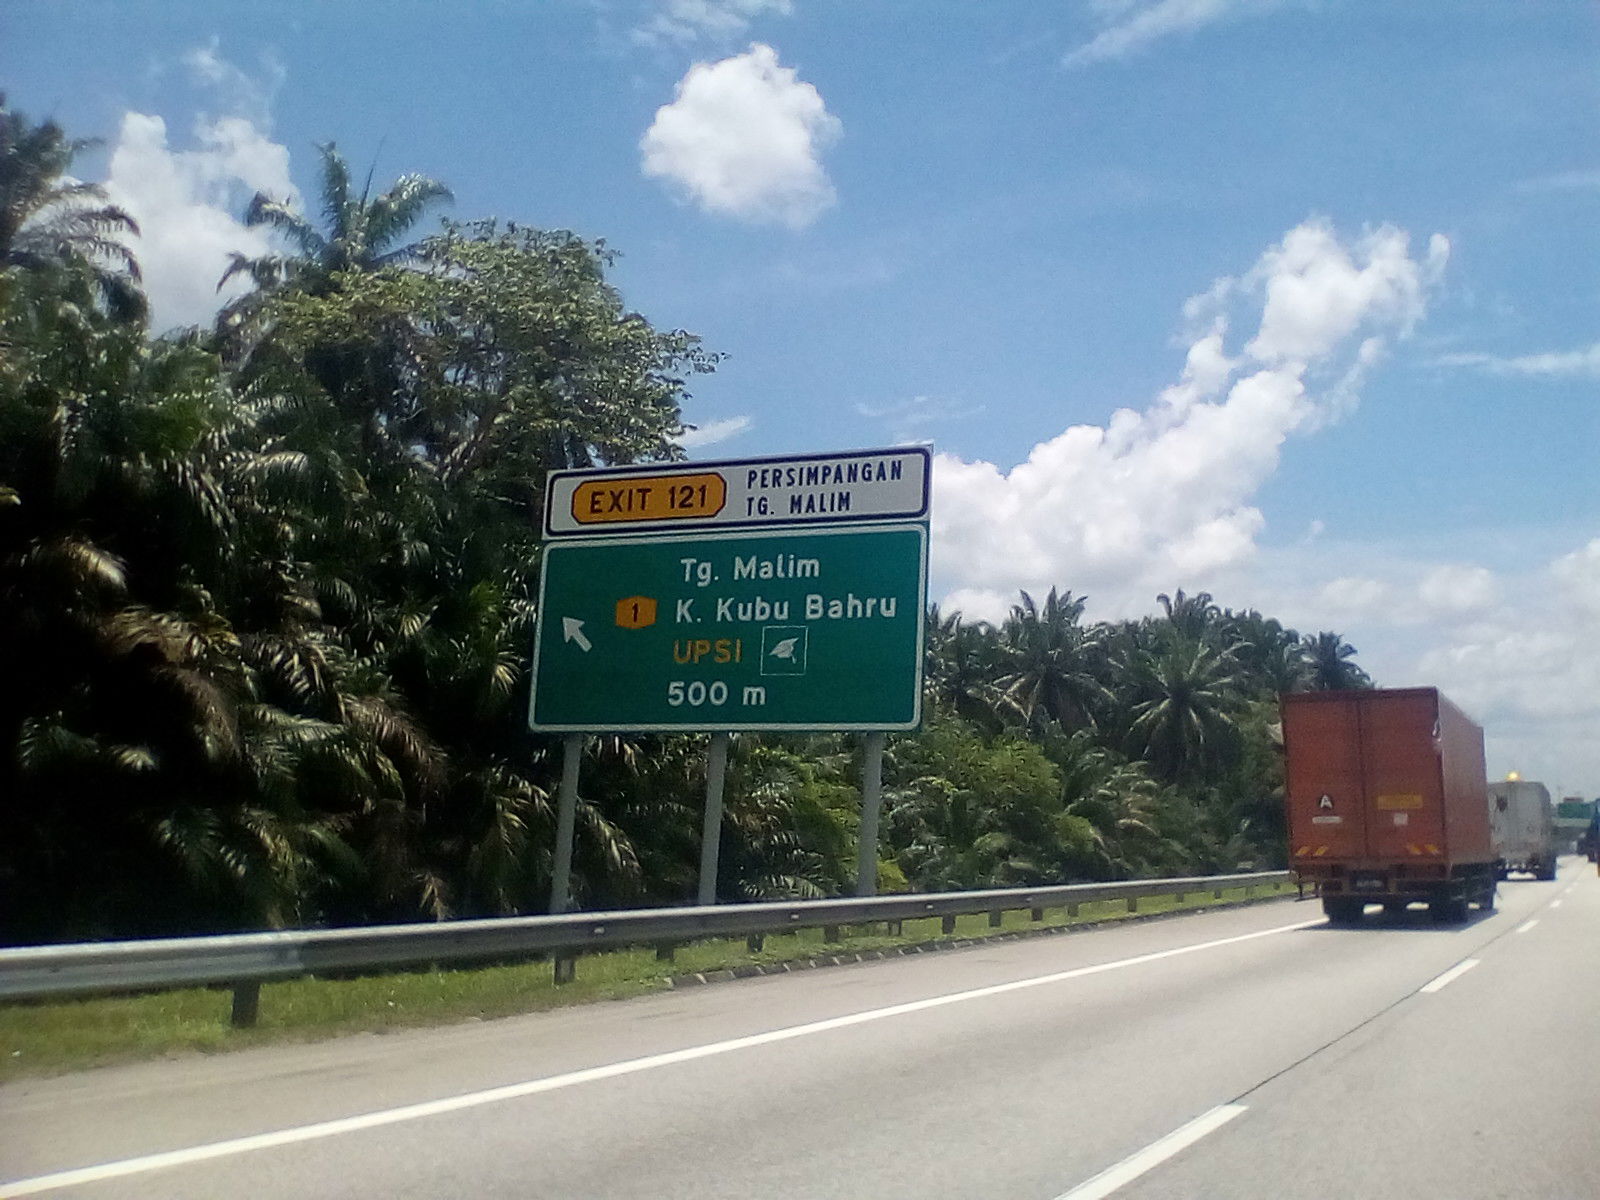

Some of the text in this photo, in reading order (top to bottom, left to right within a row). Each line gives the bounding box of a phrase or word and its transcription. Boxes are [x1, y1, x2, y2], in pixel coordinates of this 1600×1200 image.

[747, 460, 903, 490] PERSIMPANGAN
[589, 484, 708, 514] EXIT 121
[746, 491, 852, 517] TG. MALIM
[681, 554, 820, 588] Tg. Malim
[631, 602, 640, 623] 1
[676, 593, 897, 624] K. Kubu Bahru
[673, 639, 742, 664] UPSI
[667, 681, 766, 707] 500 m
